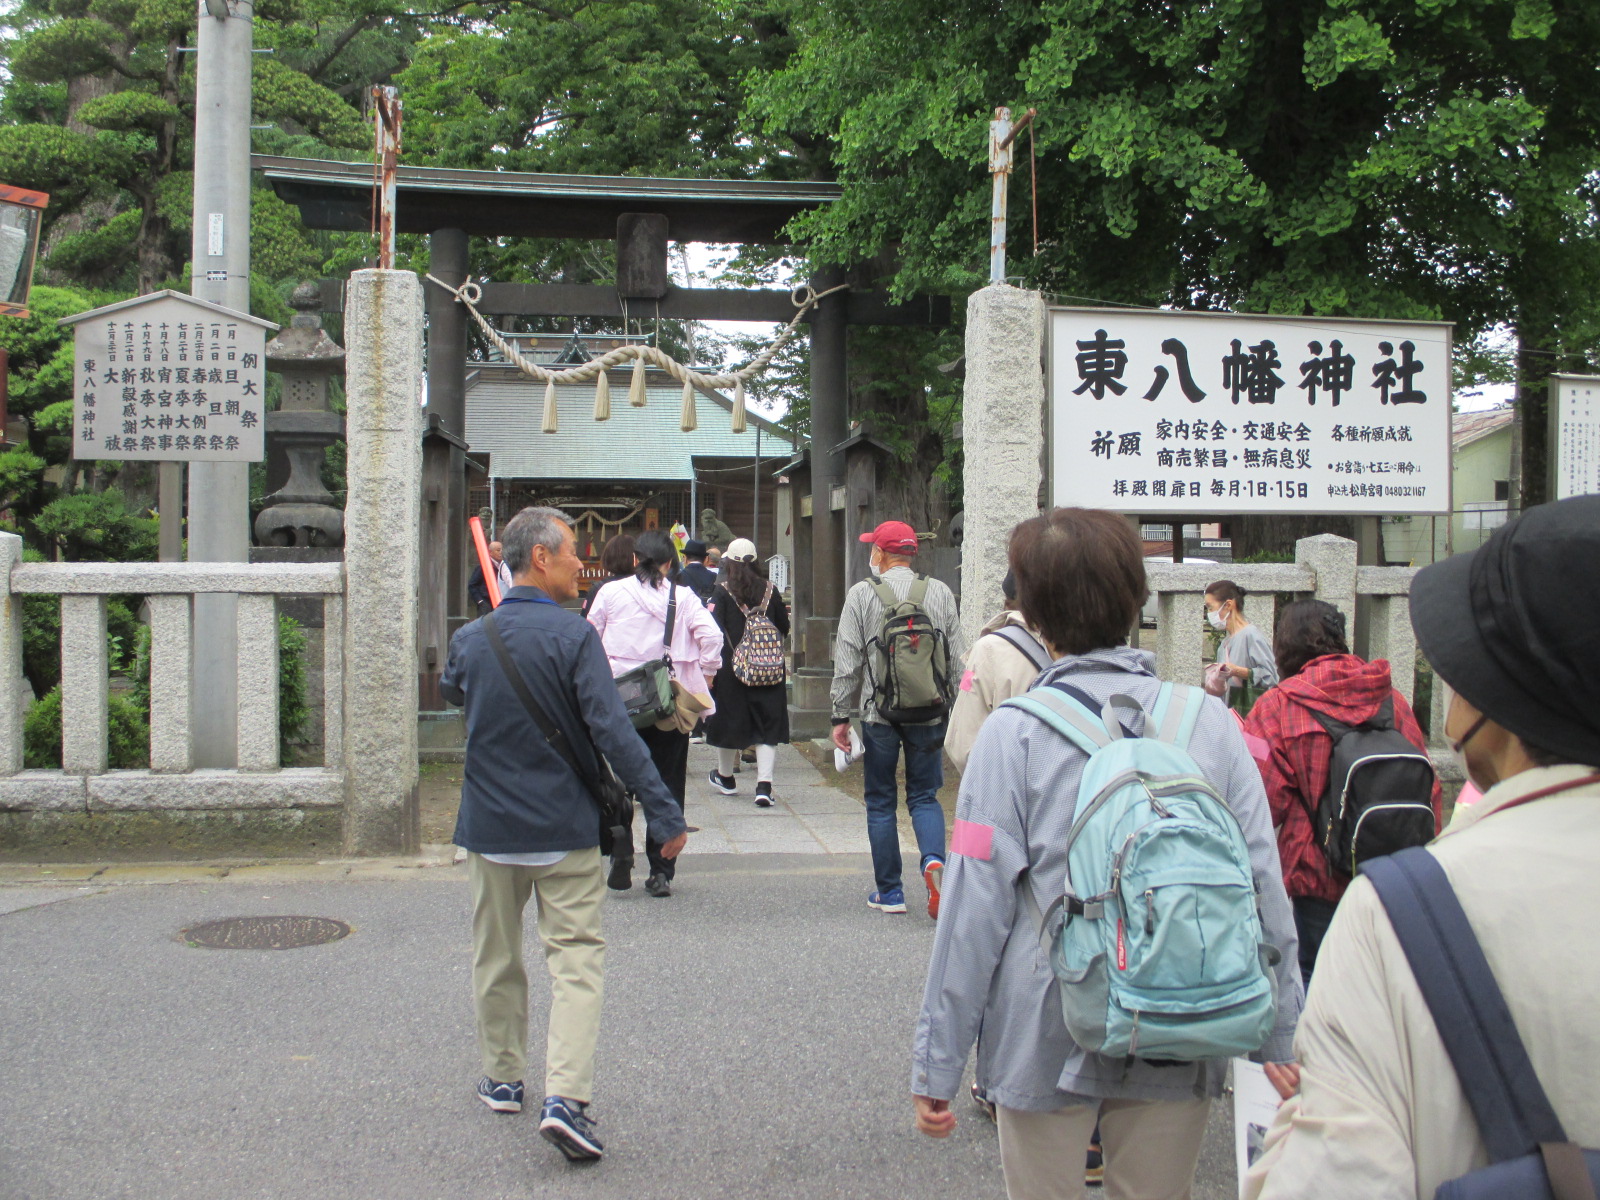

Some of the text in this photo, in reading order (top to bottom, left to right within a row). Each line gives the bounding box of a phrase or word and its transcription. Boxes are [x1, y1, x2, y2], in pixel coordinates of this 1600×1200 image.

[124, 322, 134, 361] 十一月二十日
[1072, 328, 1428, 407] 東八幡神社
[82, 359, 96, 441] 東八幡神社
[104, 368, 122, 451] 大祓
[140, 323, 156, 451] 十月十九日 秋季大祭
[157, 323, 173, 451] 十月十八日 宵宮神事
[175, 323, 191, 450] 七月二十日 夏季大祭
[192, 368, 207, 450] 春季例祭
[208, 324, 224, 450] 一月二日 歳旦祭
[225, 324, 239, 451] 一月一日 旦朝祭
[241, 353, 258, 428] 例大祭
[1090, 431, 1141, 460] 祈願
[1331, 424, 1412, 443] 各種祈願成就
[1113, 480, 1201, 498] 拝殿開扉日
